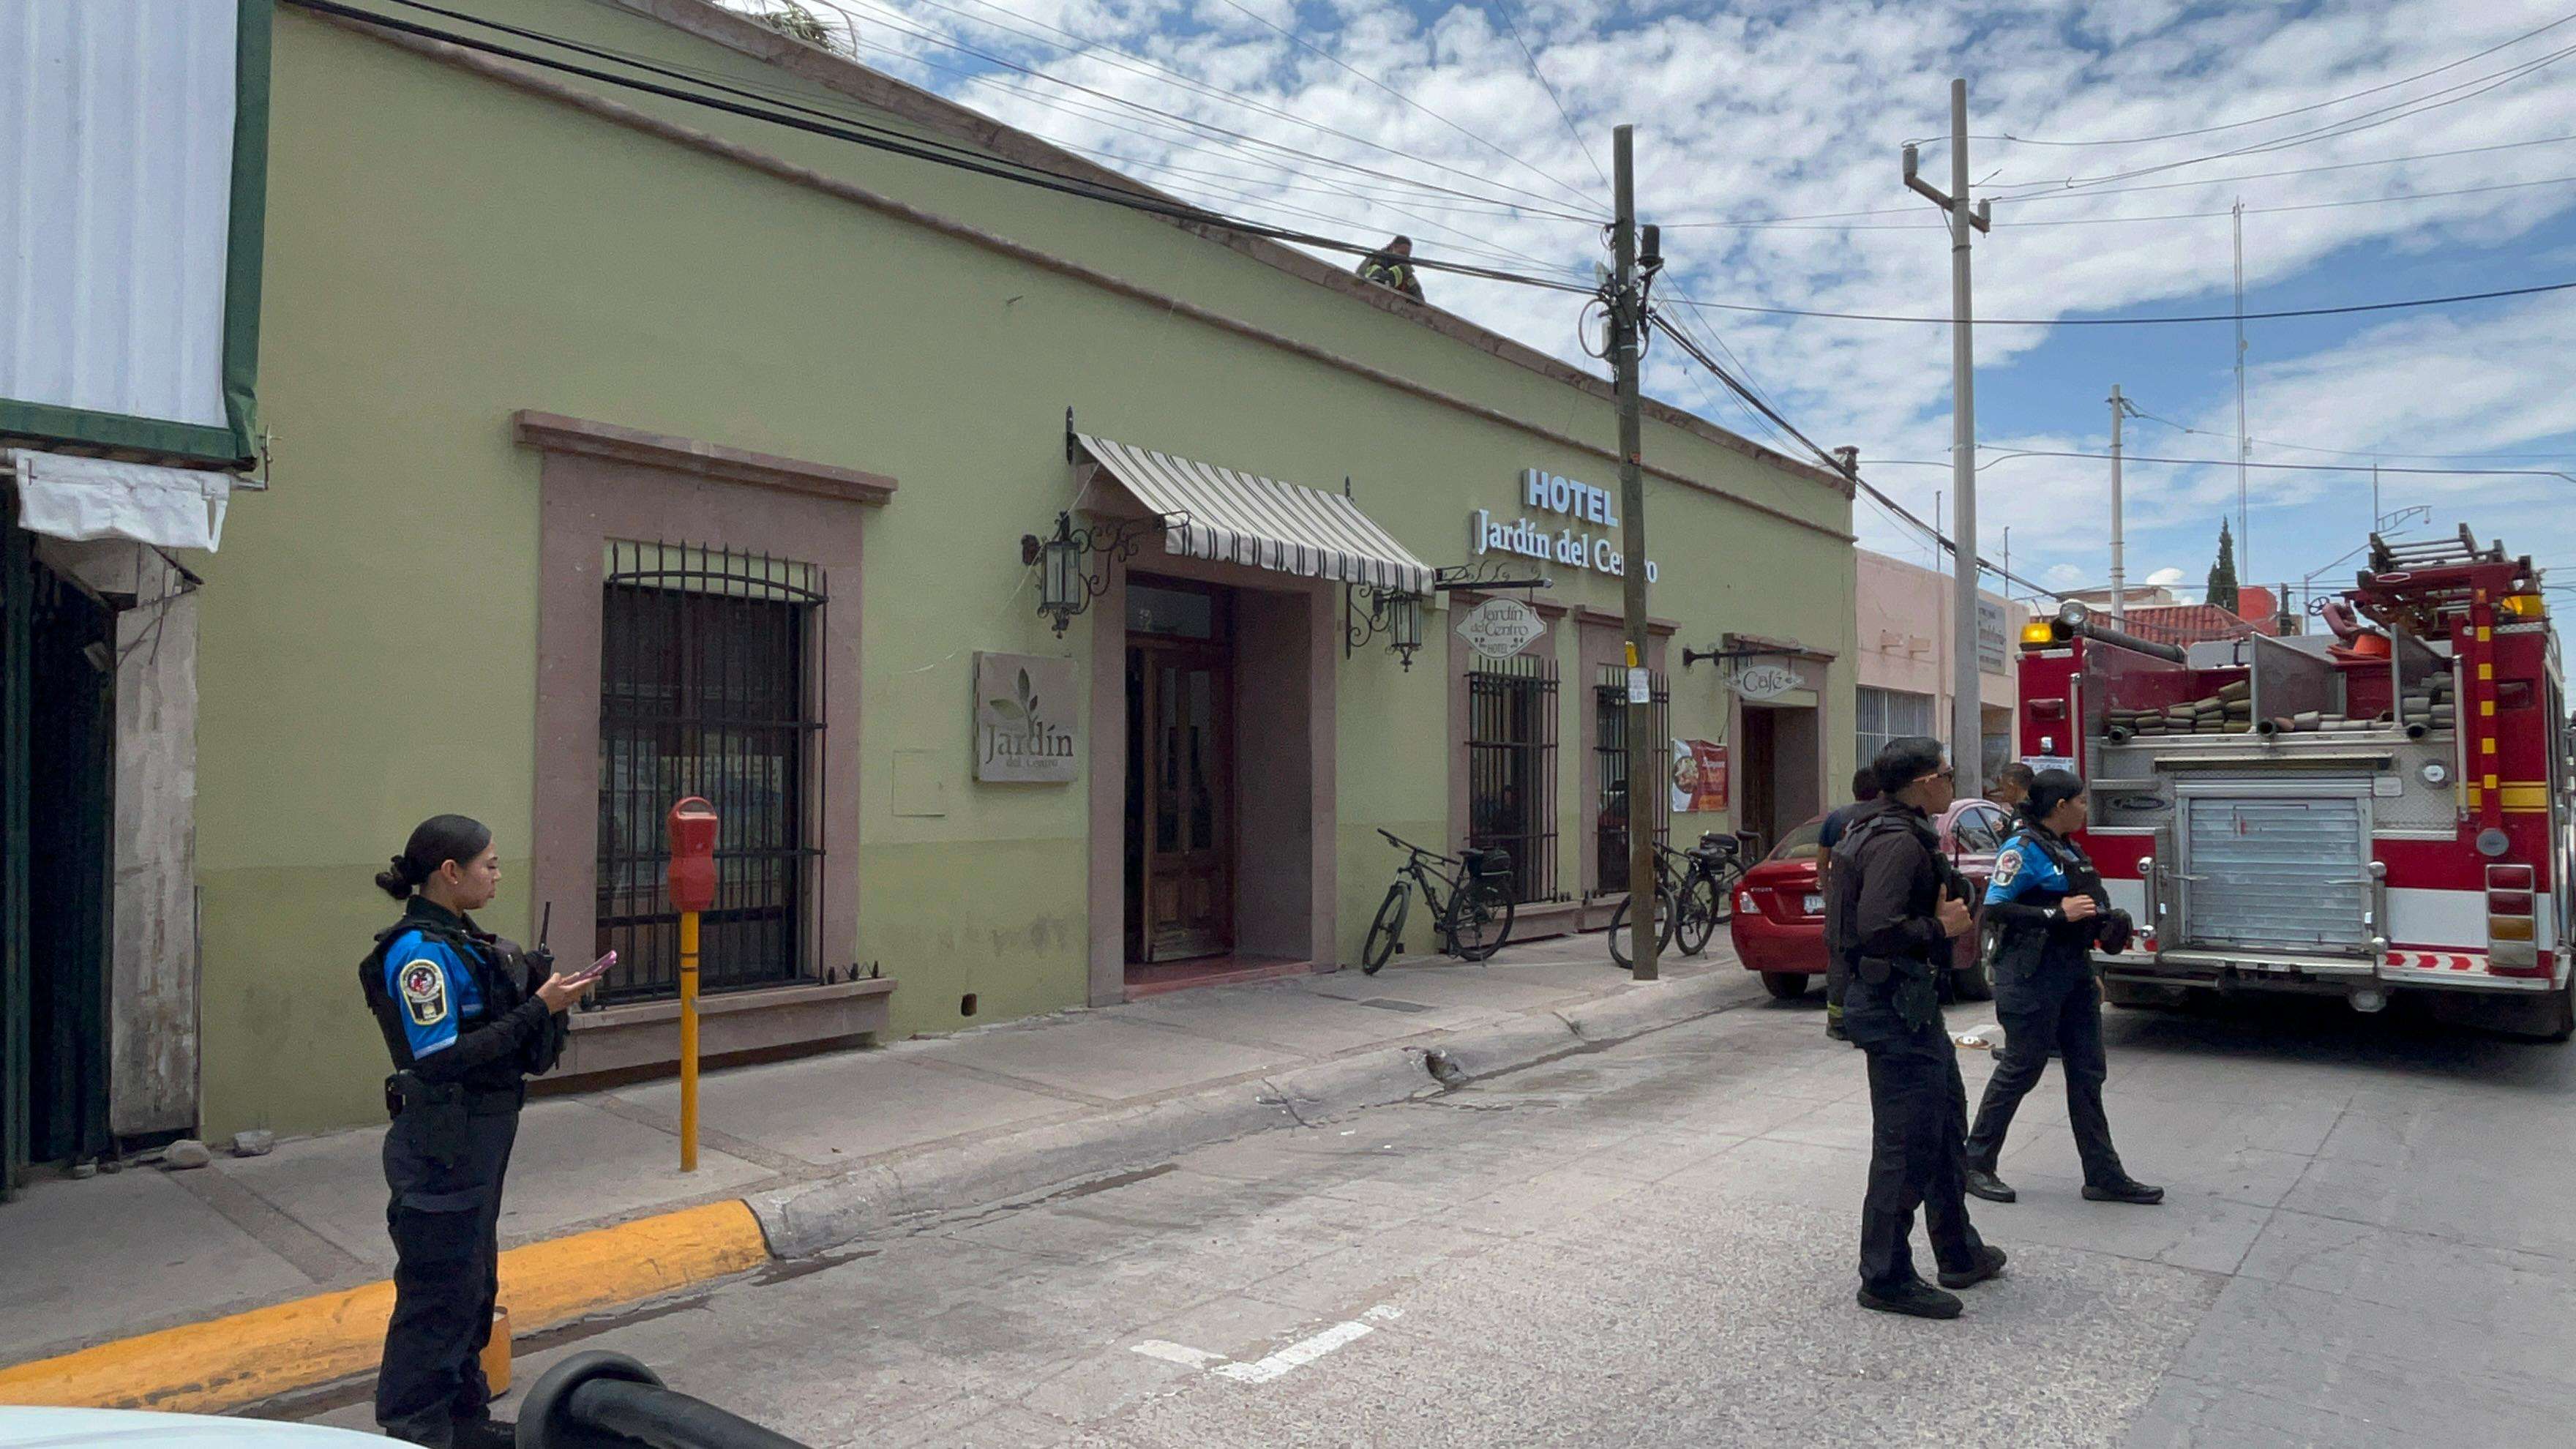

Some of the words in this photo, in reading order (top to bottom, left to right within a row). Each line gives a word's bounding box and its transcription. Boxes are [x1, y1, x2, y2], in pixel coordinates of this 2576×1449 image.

[1528, 467, 1619, 528] HOTEL
[1477, 509, 1551, 559] Jardín
[1556, 528, 1590, 569] del
[1594, 538, 1658, 584] Ceo
[1481, 605, 1524, 621] Jardín
[1485, 622, 1529, 636] Centro
[1486, 643, 1508, 654] HOTEL
[1743, 670, 1783, 693] Café
[985, 721, 1074, 765] Jardín
